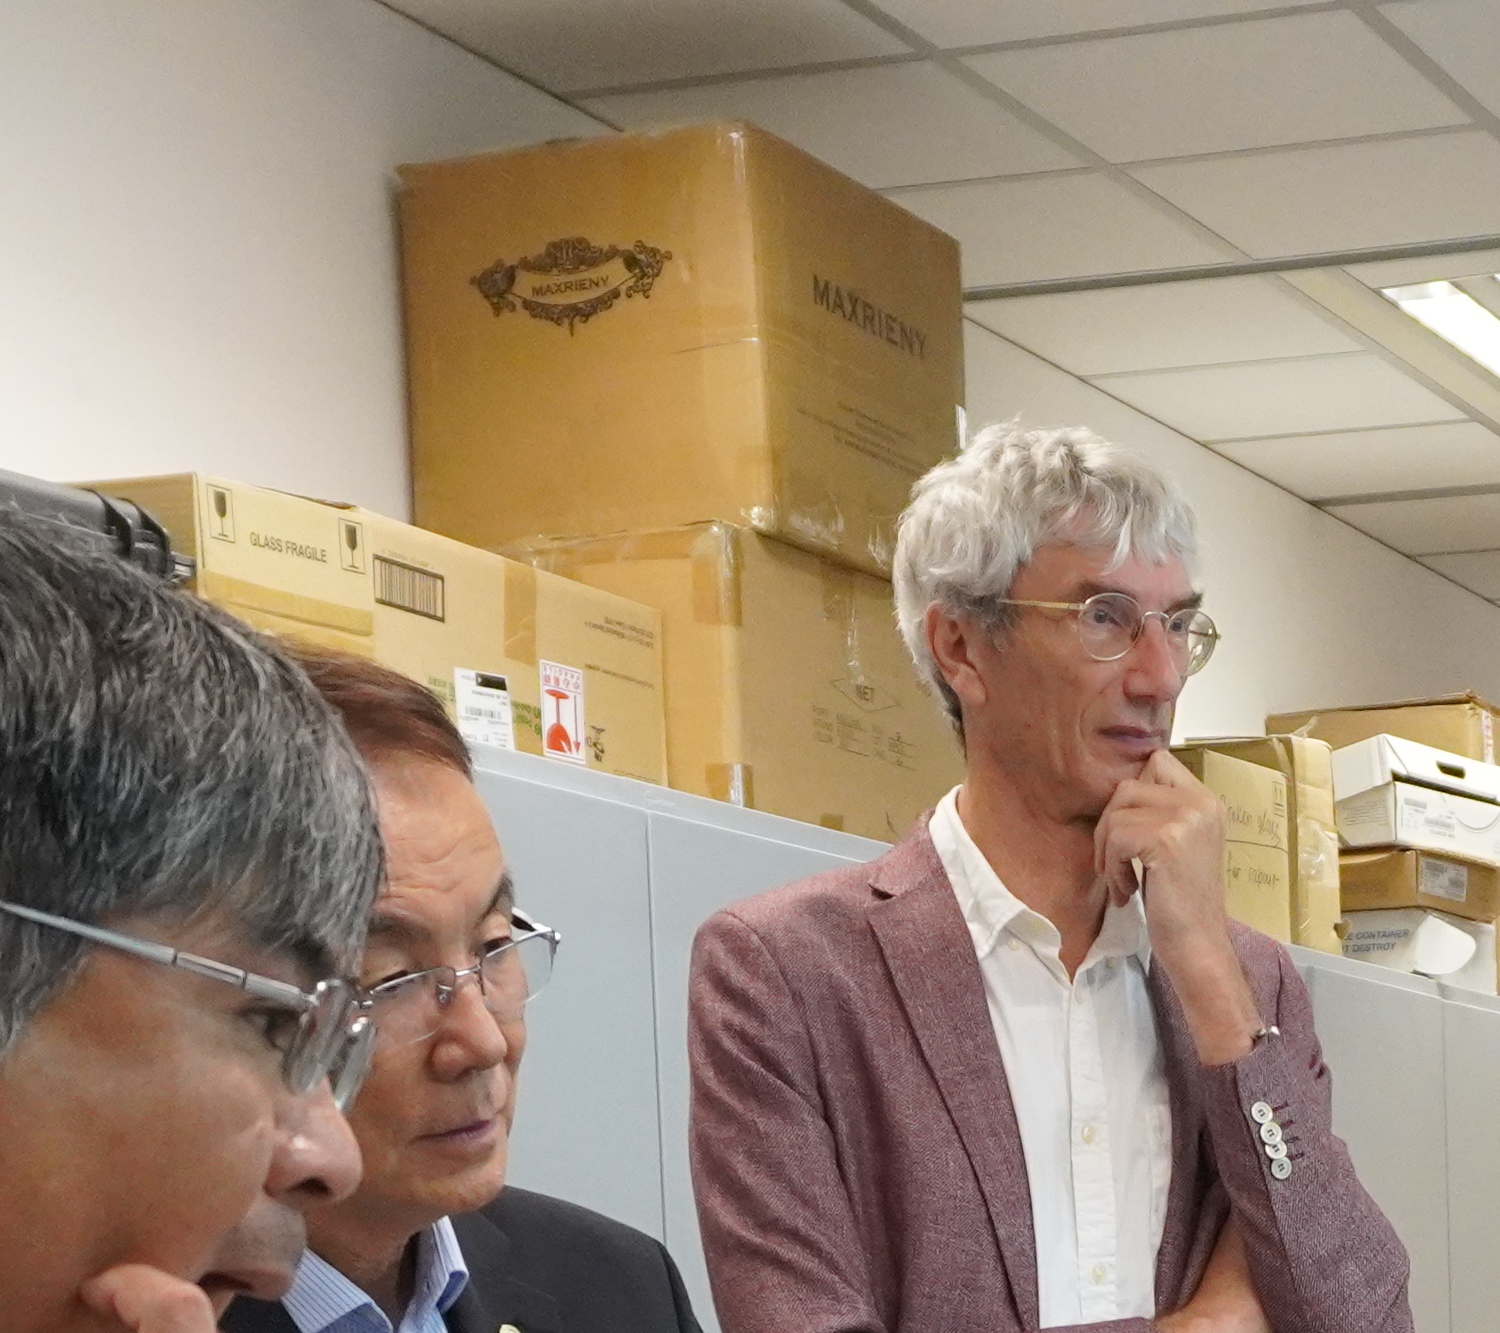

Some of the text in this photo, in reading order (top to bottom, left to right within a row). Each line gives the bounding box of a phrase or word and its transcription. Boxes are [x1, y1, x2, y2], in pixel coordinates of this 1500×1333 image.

[532, 275, 610, 297] MAXRIENY
[813, 273, 927, 359] MAXRIENY
[250, 531, 328, 564] GLASS FRAGILE
